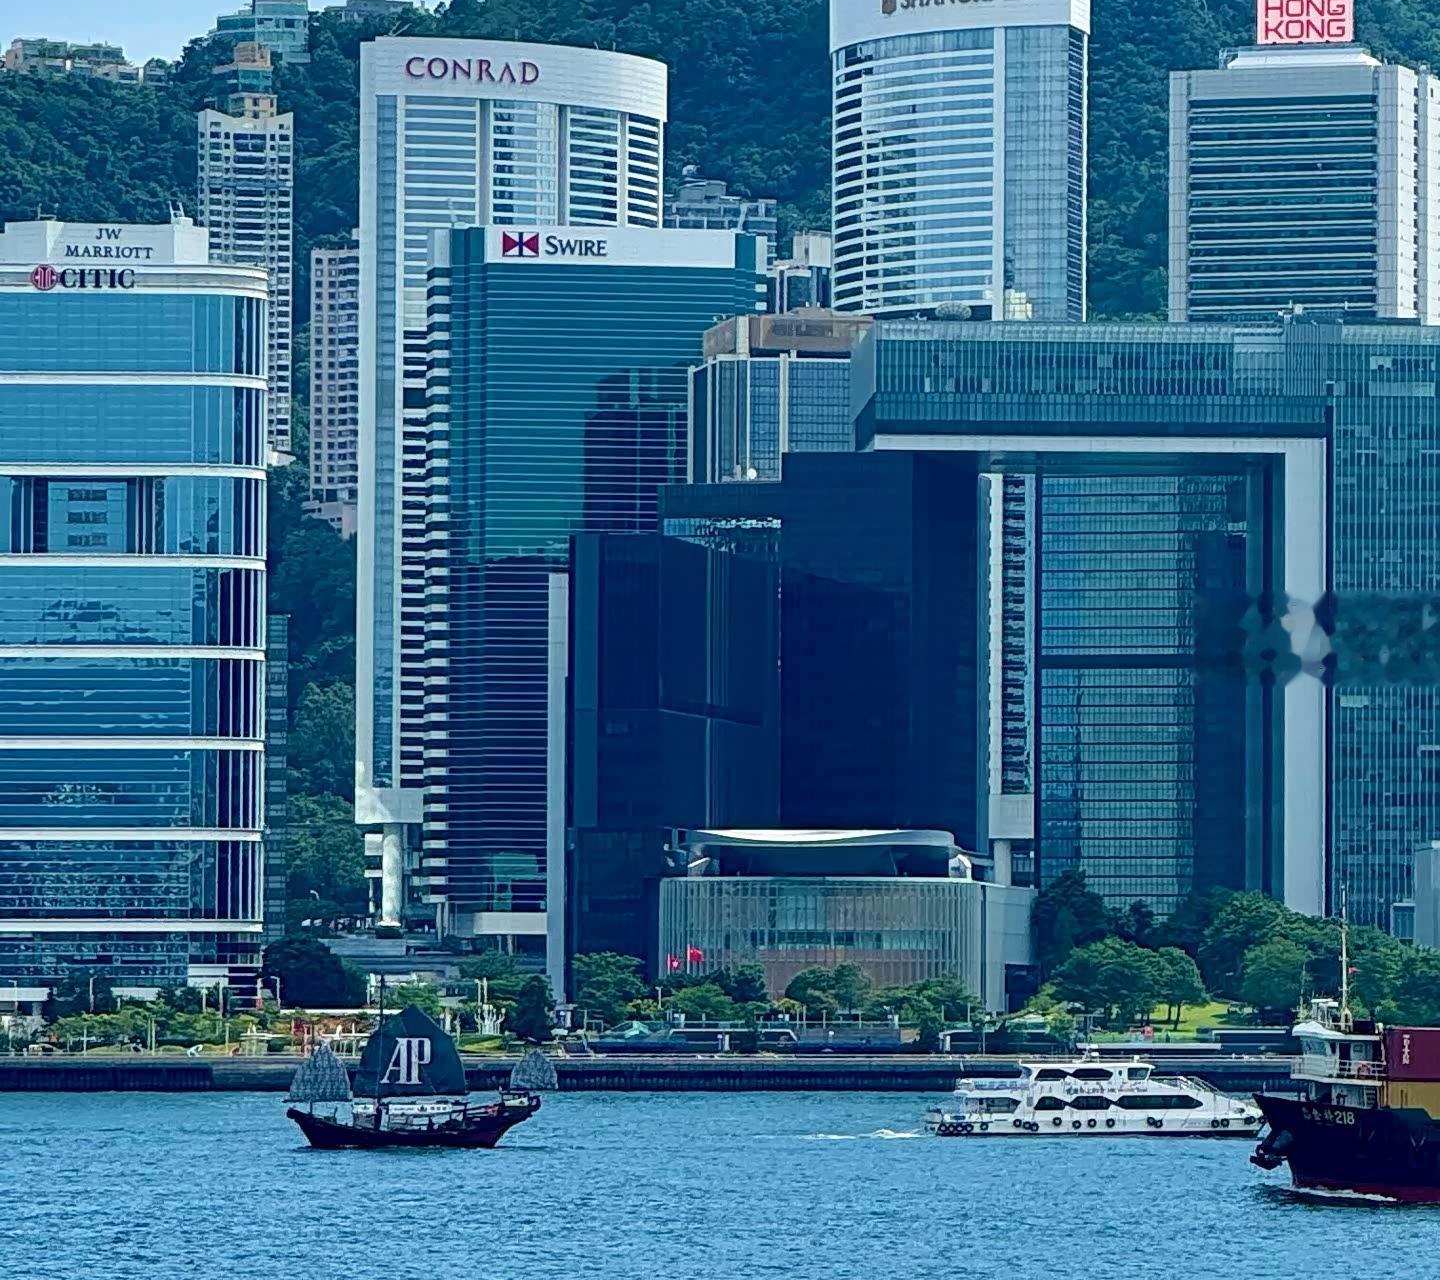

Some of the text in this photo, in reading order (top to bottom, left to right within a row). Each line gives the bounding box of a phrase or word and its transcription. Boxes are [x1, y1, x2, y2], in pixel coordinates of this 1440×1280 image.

[1264, 18, 1345, 40] KONG
[405, 56, 540, 84] CONRAD
[95, 228, 122, 240] JW
[65, 245, 153, 259] MARRIOTT
[60, 268, 135, 289] CITIC
[380, 1037, 431, 1085] AP
